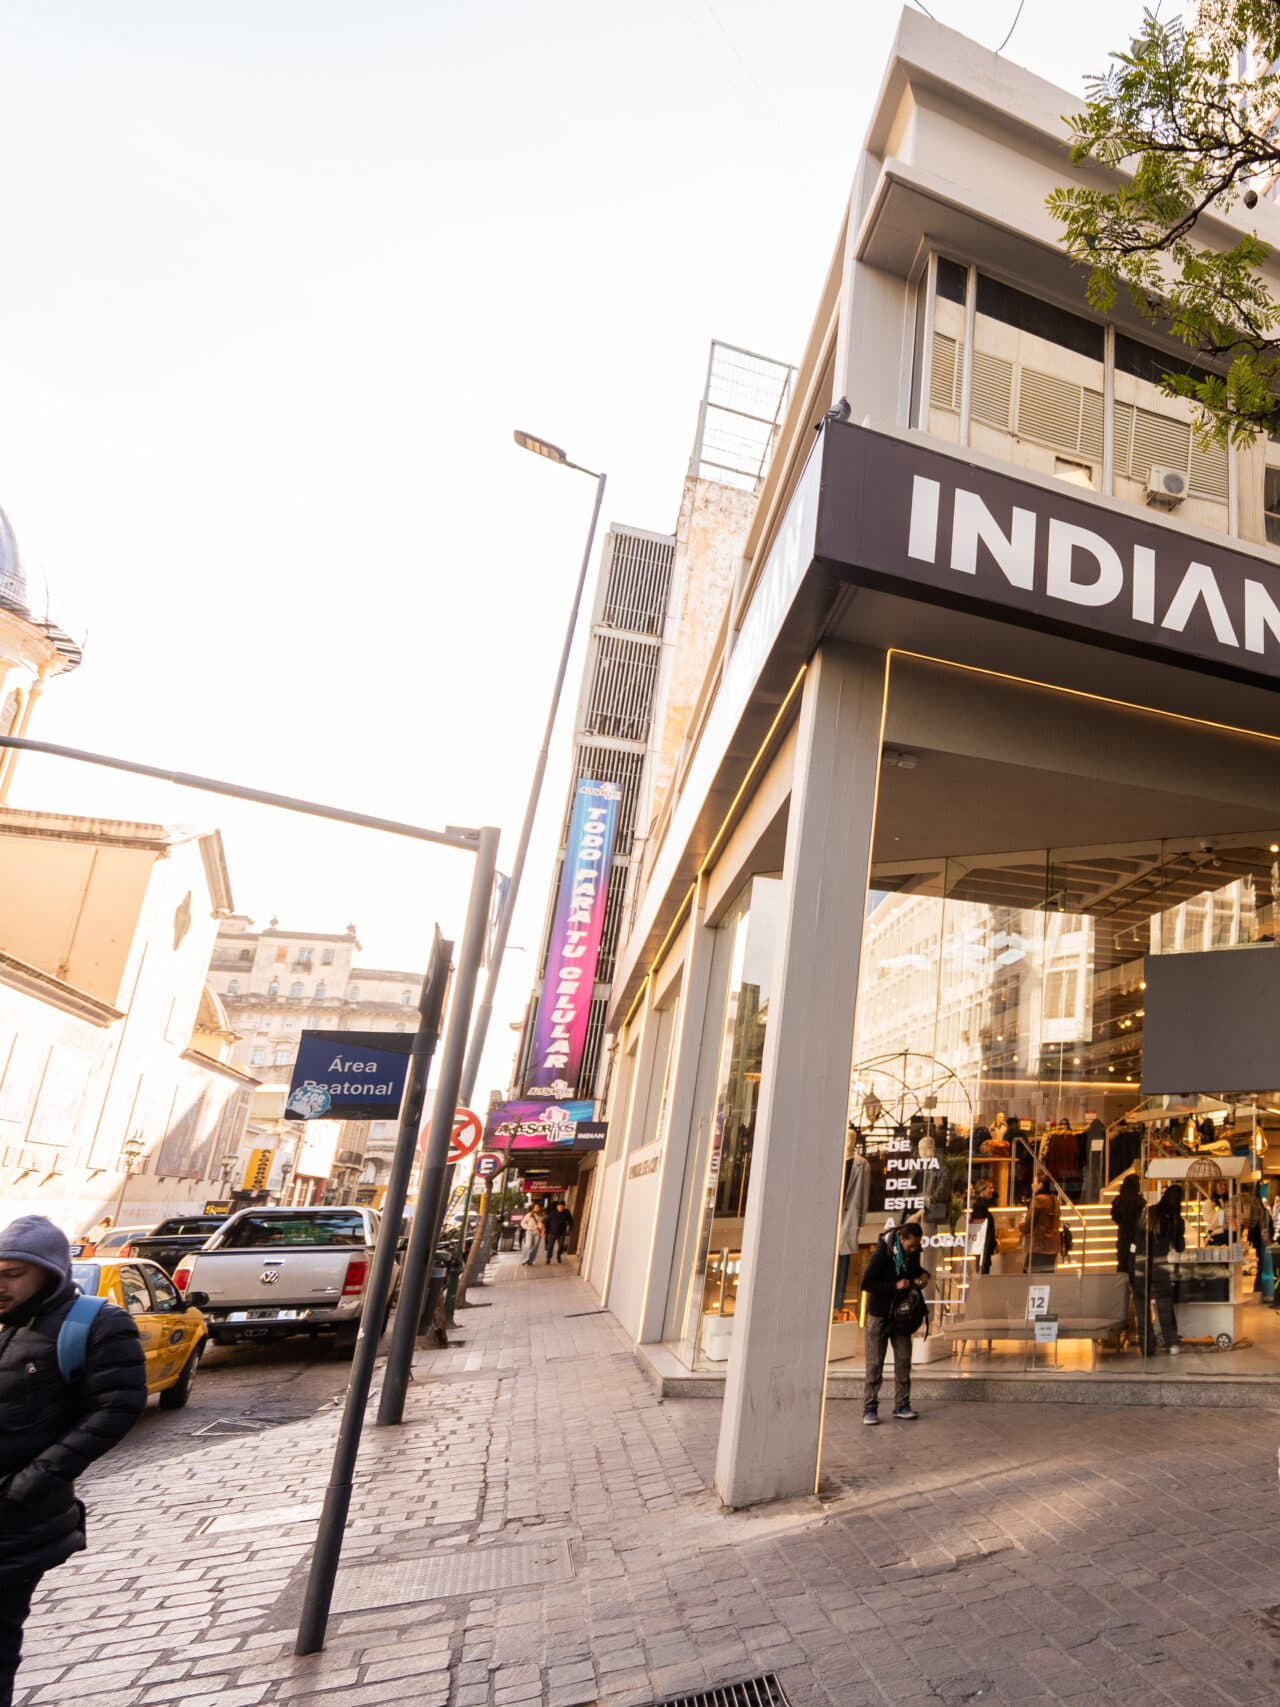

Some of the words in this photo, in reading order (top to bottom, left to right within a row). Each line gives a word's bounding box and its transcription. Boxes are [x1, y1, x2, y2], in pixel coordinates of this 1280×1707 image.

[328, 1055, 378, 1073] Área
[577, 1132, 605, 1140] INDIAN
[889, 1140, 911, 1152] DE
[480, 1159, 497, 1174] E
[887, 1158, 940, 1171] PUNTA
[885, 1178, 917, 1190] DEL
[884, 1197, 925, 1210] ESTE
[884, 1217, 896, 1230] A
[1030, 1297, 1045, 1309] 12
